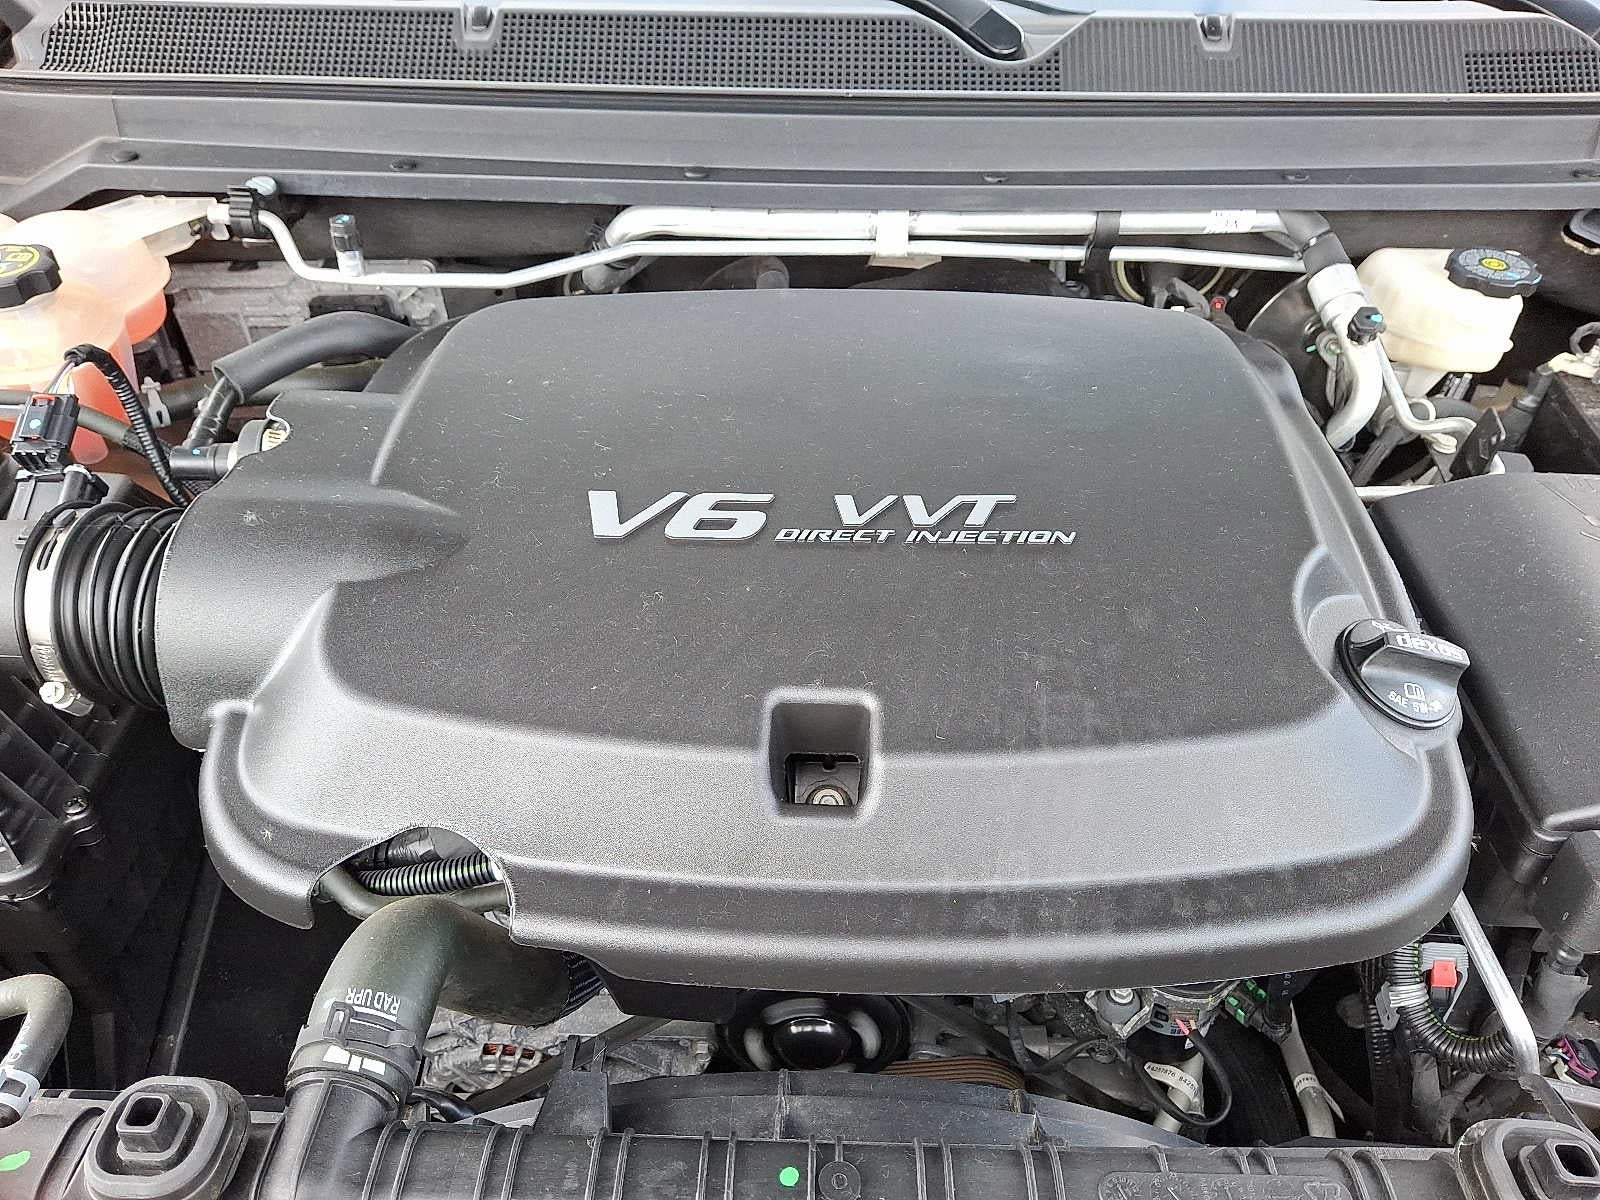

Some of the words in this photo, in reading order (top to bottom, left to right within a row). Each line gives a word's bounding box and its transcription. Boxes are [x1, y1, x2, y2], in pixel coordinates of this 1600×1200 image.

[588, 490, 775, 540] V6
[834, 494, 1017, 527] VVT
[774, 528, 896, 543] DIRECT
[903, 529, 1077, 545] INJECTION
[1388, 690, 1408, 708] SAE
[345, 987, 373, 1006] UPR
[374, 991, 401, 1015] RAD
